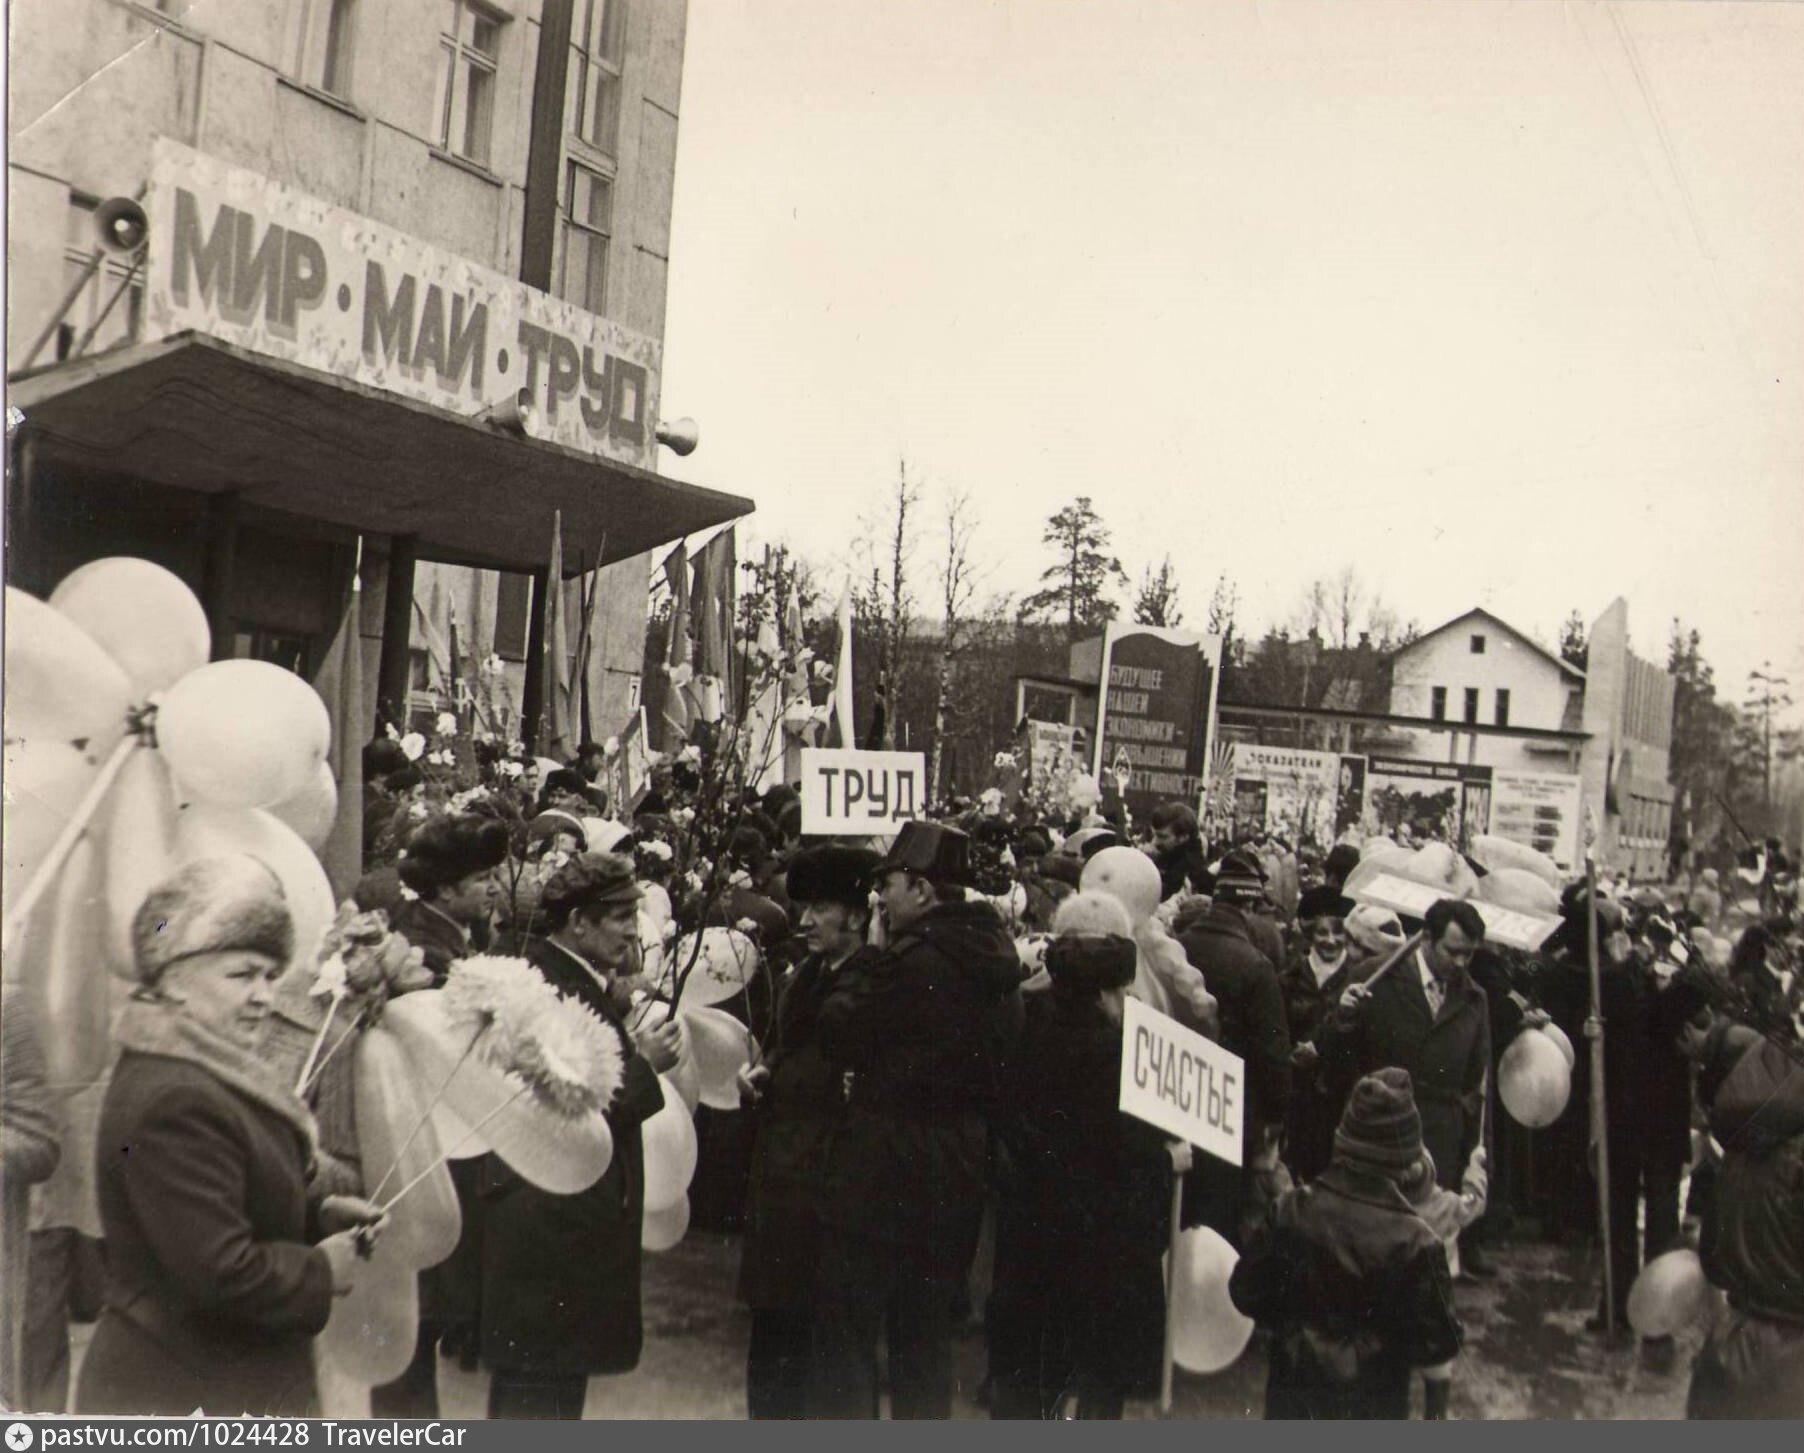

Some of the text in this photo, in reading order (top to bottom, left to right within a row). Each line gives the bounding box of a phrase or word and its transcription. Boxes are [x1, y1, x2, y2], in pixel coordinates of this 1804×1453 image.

[173, 188, 648, 447] МИР МАЙ ТРУД
[818, 767, 916, 823] ТРУД
[1134, 1025, 1236, 1137] СЧАСТЬЕ
